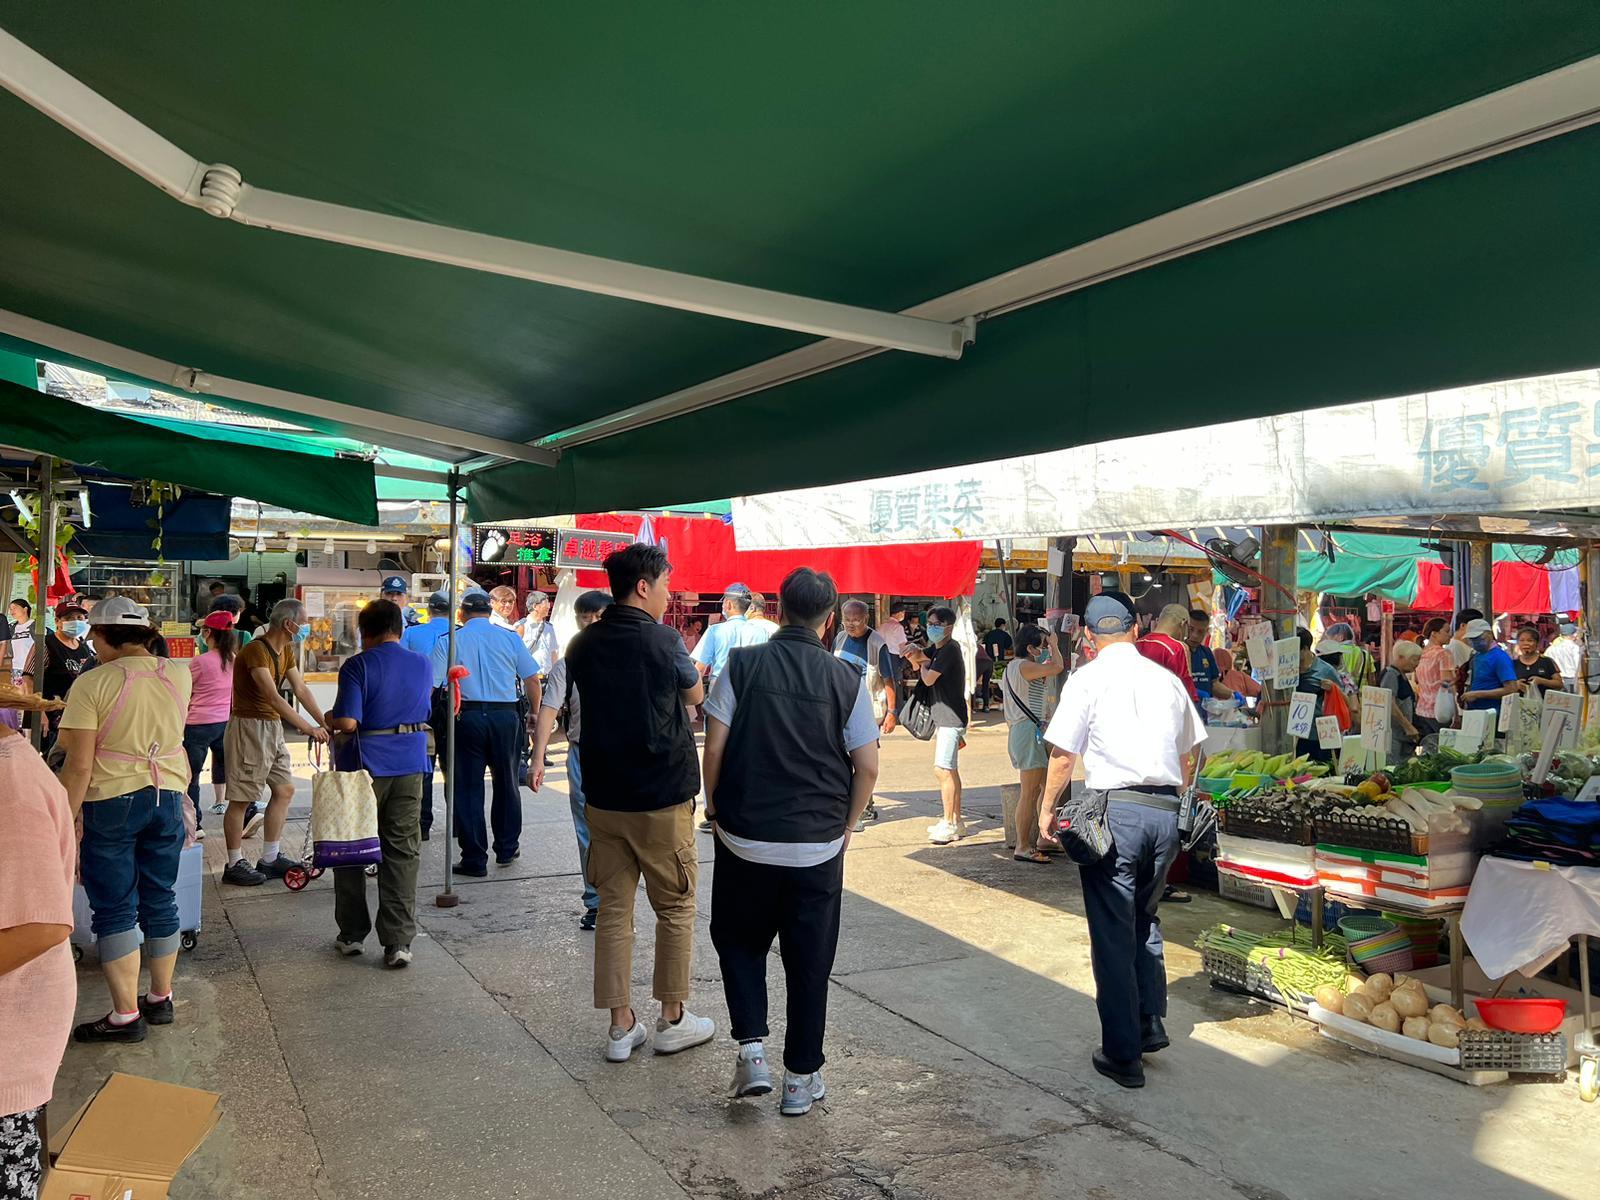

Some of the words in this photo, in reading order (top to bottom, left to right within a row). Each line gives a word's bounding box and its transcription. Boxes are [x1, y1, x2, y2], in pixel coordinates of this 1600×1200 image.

[506, 531, 543, 546] 足浴
[517, 547, 552, 562] 推拿
[1292, 704, 1309, 720] 10
